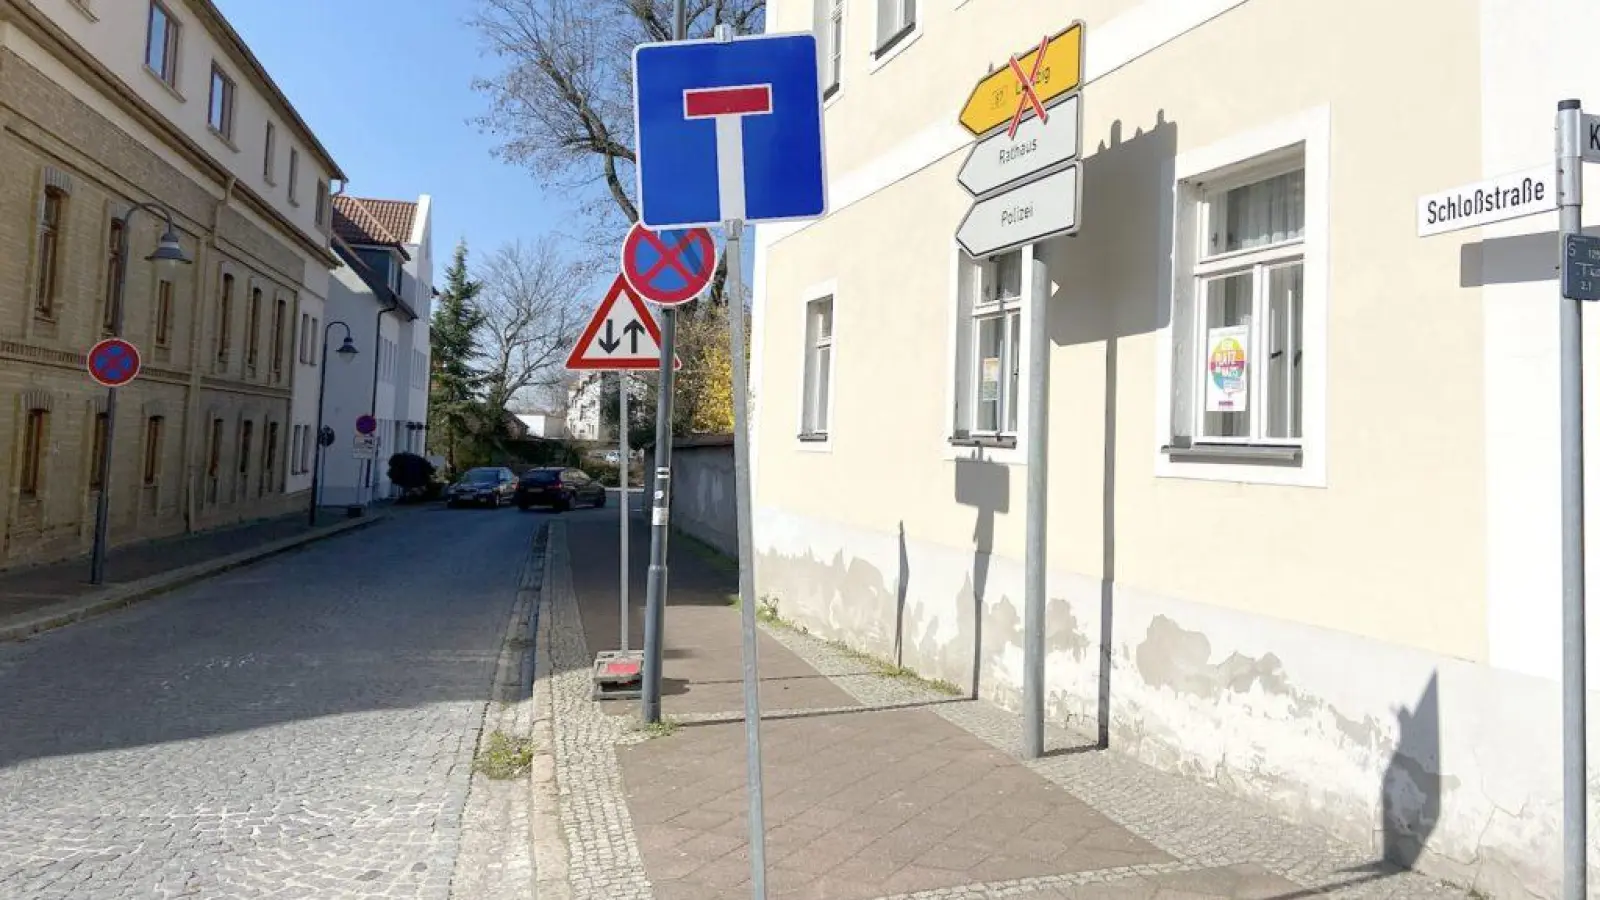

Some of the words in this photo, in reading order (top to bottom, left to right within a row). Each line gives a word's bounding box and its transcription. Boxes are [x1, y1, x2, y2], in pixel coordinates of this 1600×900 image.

[999, 138, 1037, 165] Rathaus
[1001, 201, 1034, 227] Polizei
[1427, 177, 1545, 224] Schloßstraße
